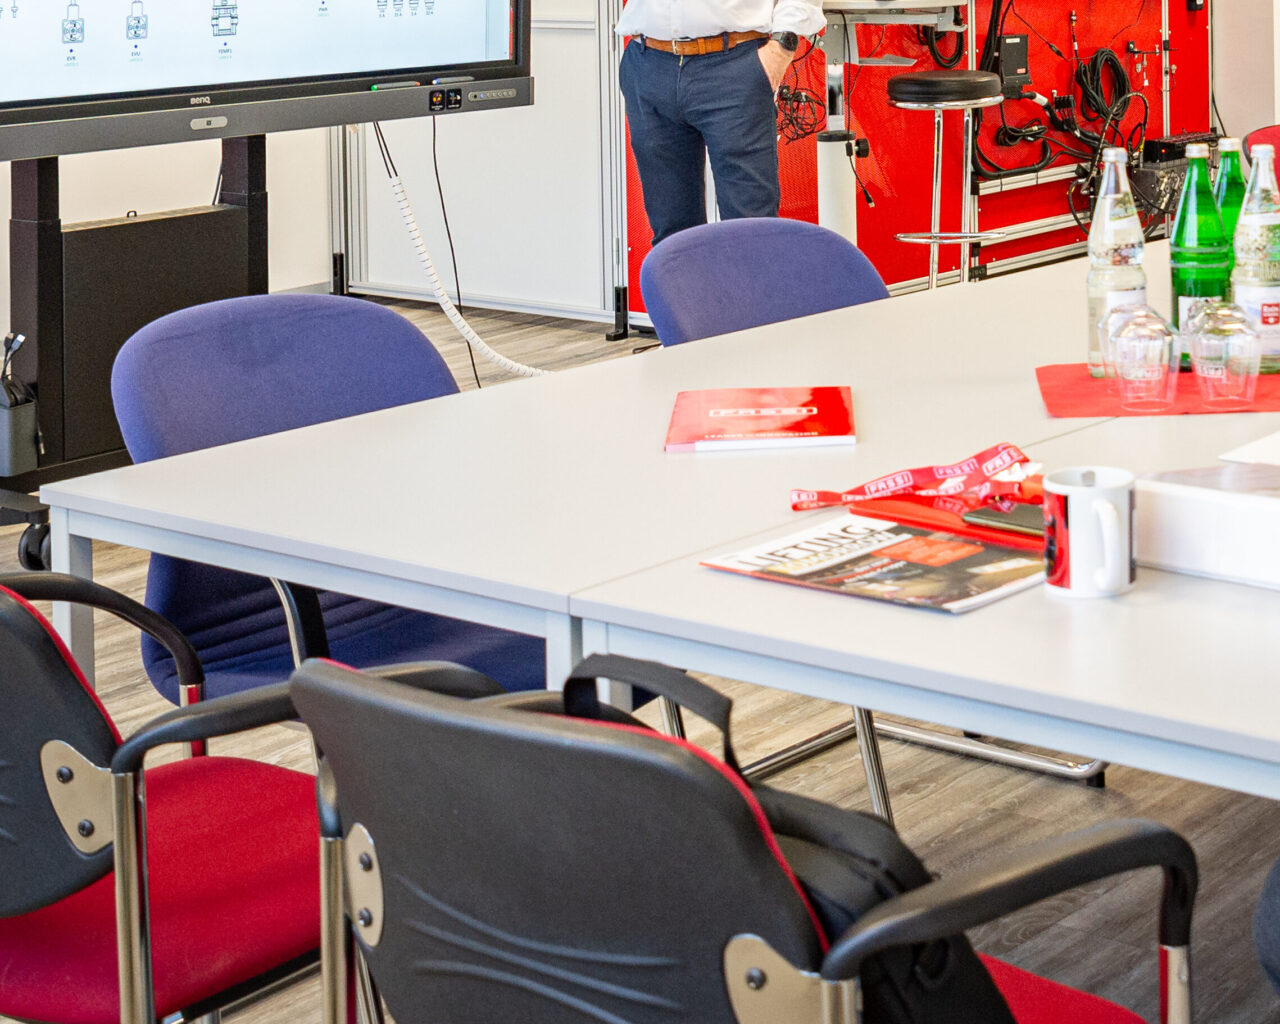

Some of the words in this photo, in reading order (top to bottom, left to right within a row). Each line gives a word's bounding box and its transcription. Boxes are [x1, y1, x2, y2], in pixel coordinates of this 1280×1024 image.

[190, 96, 211, 105] BenQ
[866, 472, 912, 496] FASSI
[737, 524, 879, 568] LIFTING
